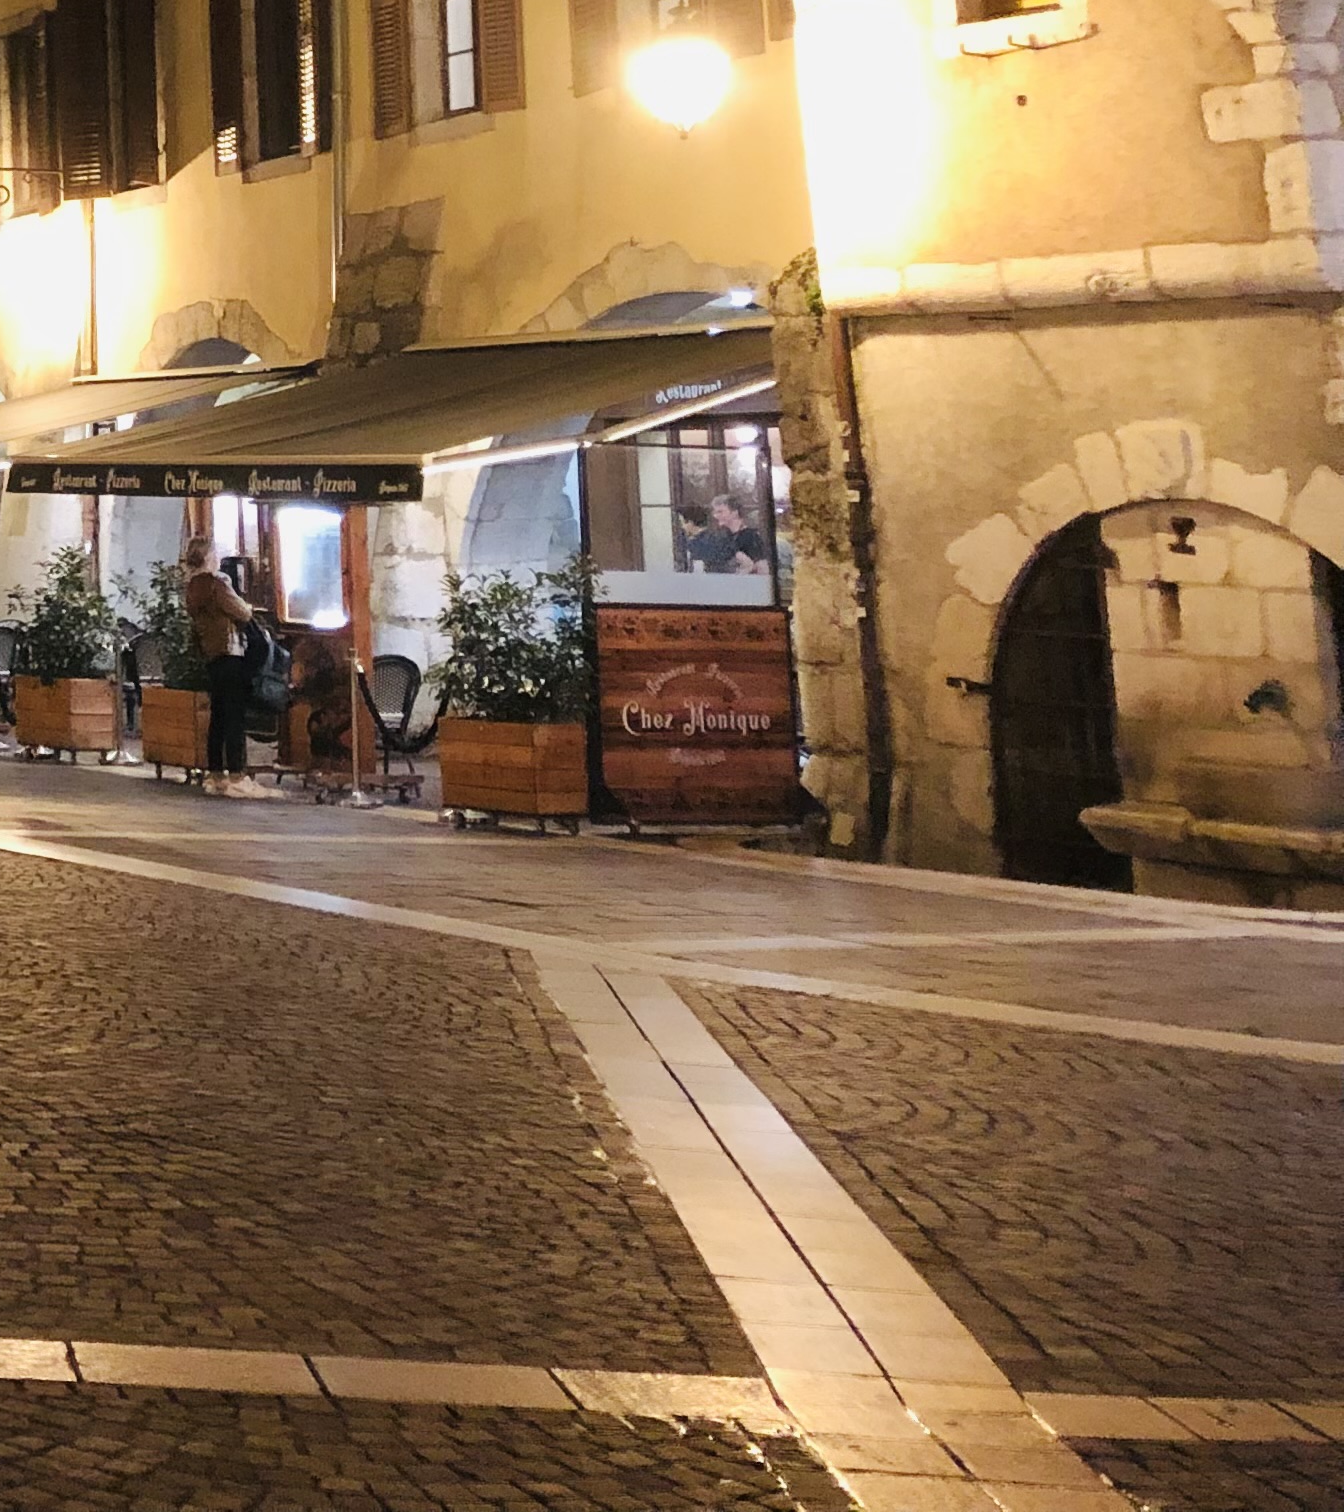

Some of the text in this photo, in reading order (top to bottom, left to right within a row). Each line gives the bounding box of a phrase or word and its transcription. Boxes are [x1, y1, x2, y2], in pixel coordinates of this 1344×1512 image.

[655, 379, 722, 404] Restaurant
[164, 470, 186, 495] Chez
[248, 469, 302, 496] Restaurant
[313, 468, 357, 498] Pizzeria
[622, 699, 772, 737] Chez Monique
